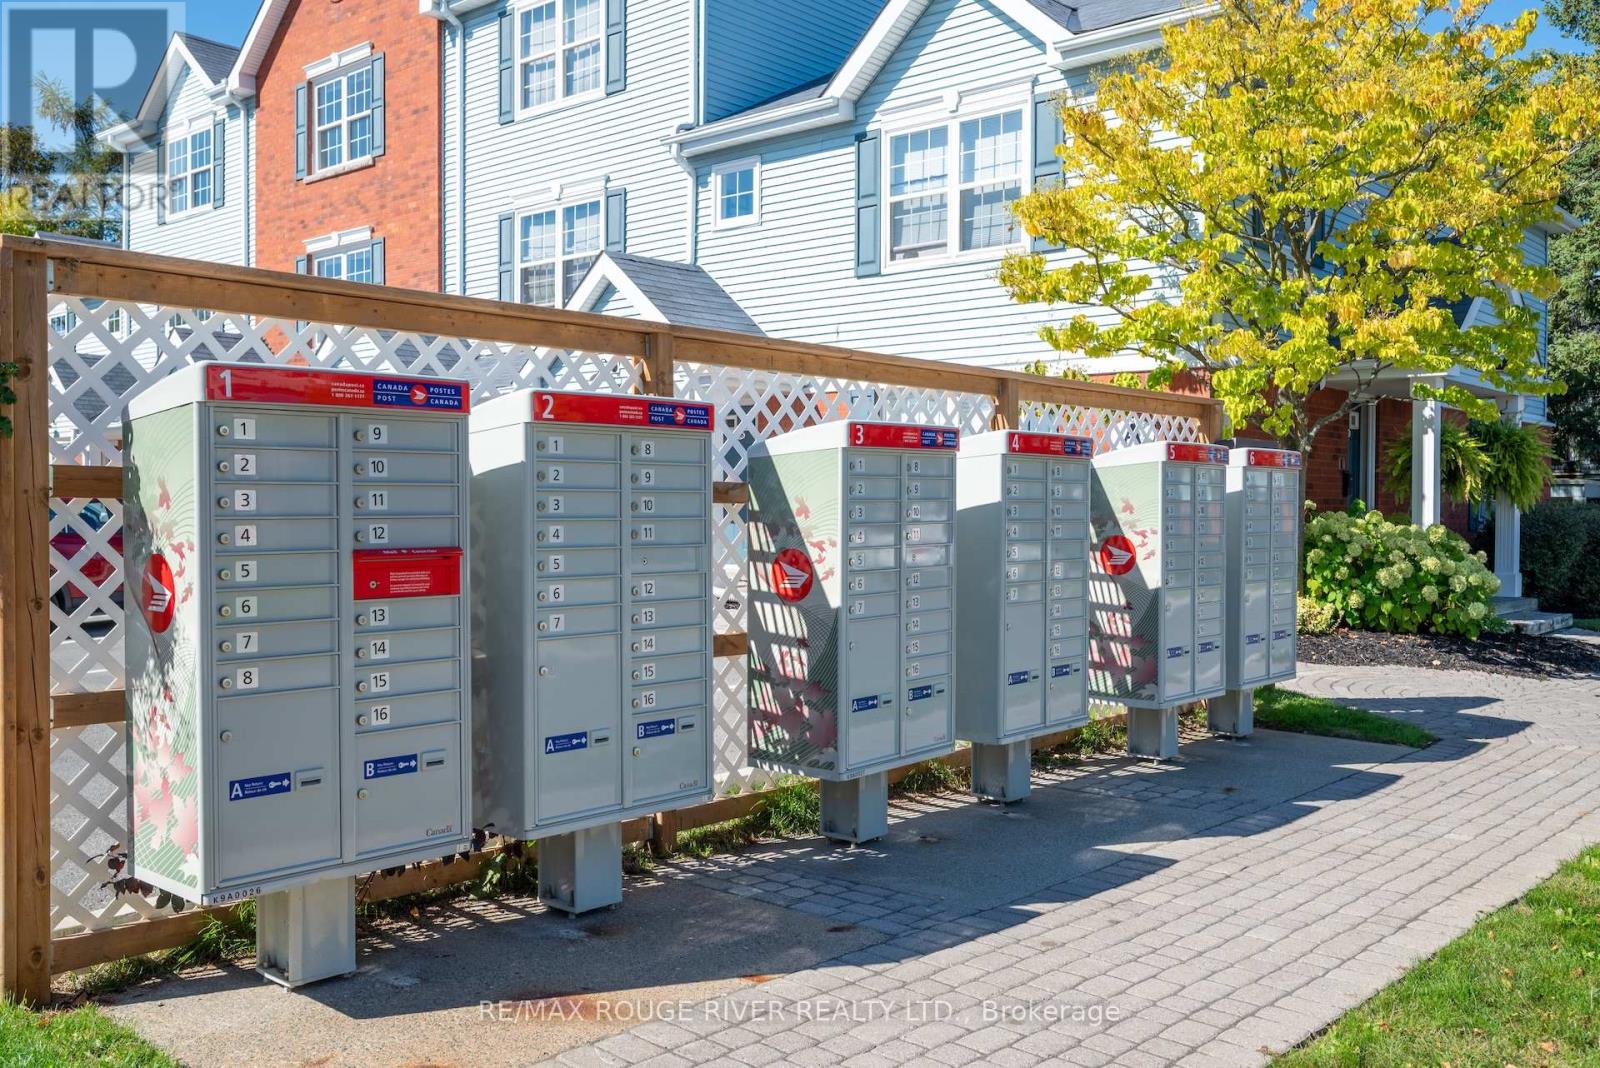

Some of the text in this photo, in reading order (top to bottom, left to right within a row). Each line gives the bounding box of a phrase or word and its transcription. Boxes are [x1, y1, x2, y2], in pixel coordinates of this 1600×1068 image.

[219, 369, 233, 398] 1
[377, 383, 409, 391] CANADA
[429, 387, 456, 395] POSTES
[377, 394, 396, 402] POST
[430, 398, 459, 406] CANADA
[542, 395, 555, 419] 2
[241, 423, 246, 435] 1
[373, 428, 381, 440] 9
[856, 425, 864, 444] 3
[554, 440, 557, 451] 1
[1012, 434, 1019, 451] 4
[645, 444, 651, 454] 8
[1170, 445, 1175, 460] 5
[1250, 452, 1255, 464] 6
[241, 458, 249, 471] 2
[371, 460, 385, 474] 10
[554, 470, 560, 480] 2
[645, 472, 651, 482] 9
[858, 484, 862, 493] 2
[914, 485, 918, 494] 9
[241, 494, 250, 507] 3
[372, 494, 384, 506] 11
[554, 500, 560, 510] 3
[644, 500, 652, 510] 10
[858, 508, 862, 517] 3
[241, 529, 250, 542] 4
[372, 527, 385, 540] 12
[553, 529, 560, 539] 4
[644, 528, 652, 538] 11
[554, 559, 560, 569] 5
[241, 564, 250, 577] 5
[644, 583, 653, 594] 12
[858, 579, 862, 588] 6
[554, 588, 560, 599] 6
[242, 600, 250, 613] 6
[372, 609, 386, 622] 13
[644, 611, 653, 622] 13
[554, 618, 560, 628] 7
[243, 636, 251, 649] 7
[372, 641, 387, 655] 14
[644, 638, 653, 649] 14
[644, 666, 653, 677] 15
[243, 671, 252, 685] 8
[372, 675, 387, 688] 15
[644, 694, 653, 704] 16
[853, 701, 858, 711] A
[373, 707, 388, 721] 16
[638, 725, 645, 737] B
[546, 740, 554, 752] A
[366, 763, 374, 777] B
[231, 783, 242, 798] A
[425, 824, 454, 837] Canada
